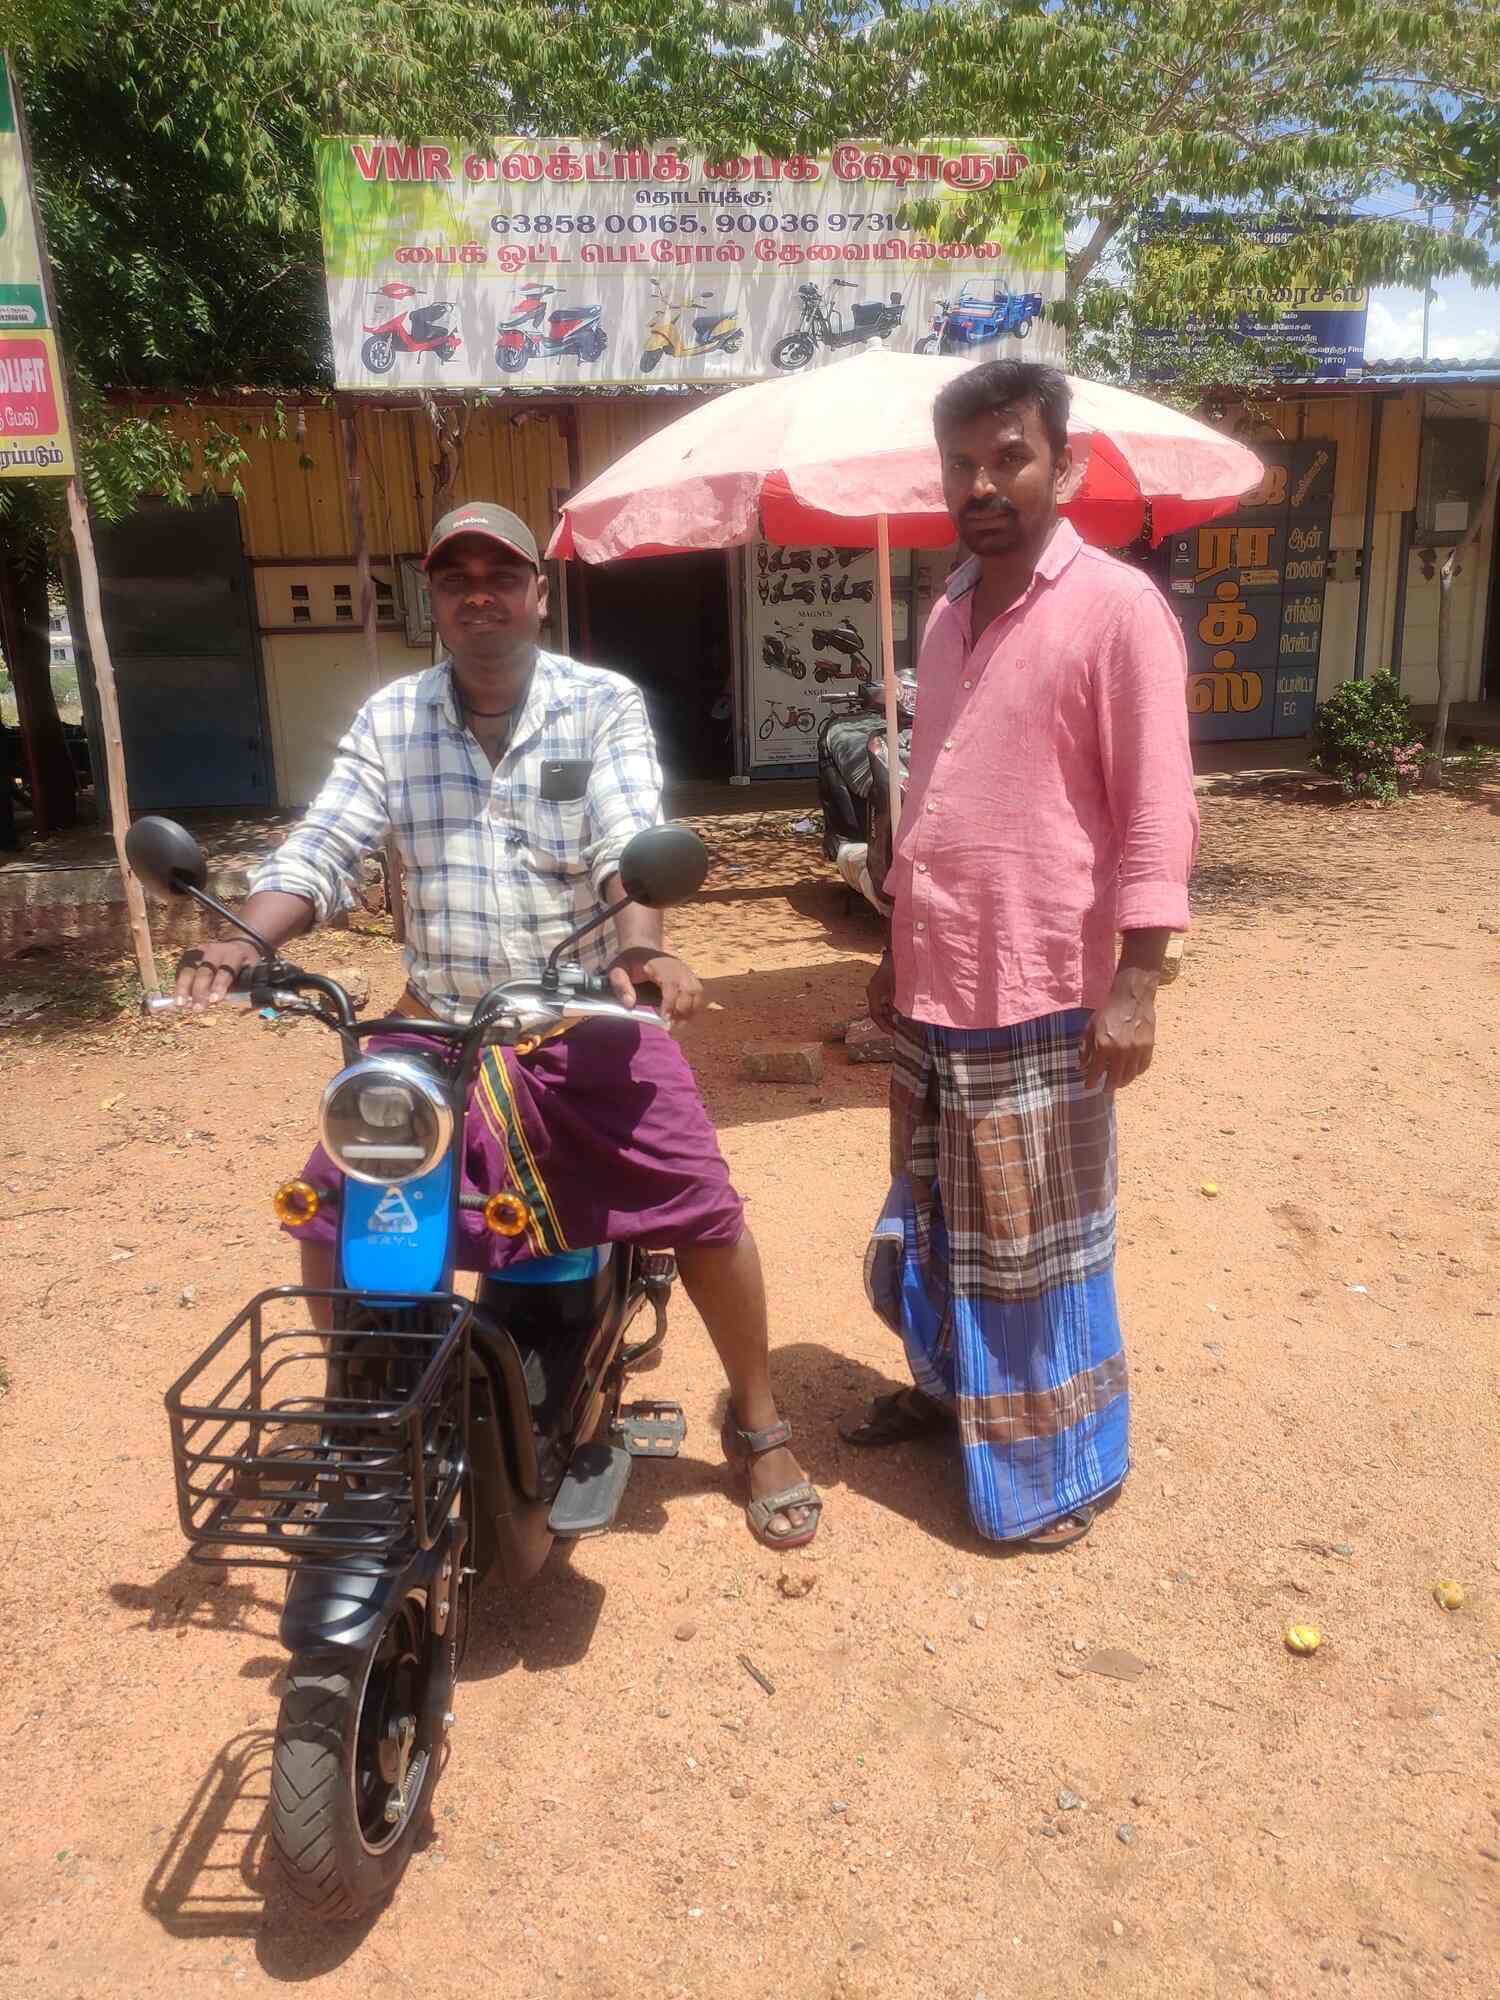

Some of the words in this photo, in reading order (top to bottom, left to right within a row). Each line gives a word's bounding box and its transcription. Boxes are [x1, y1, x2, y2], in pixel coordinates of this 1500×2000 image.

[352, 145, 454, 183] VMR
[490, 214, 595, 235] 63858
[716, 213, 819, 234] 90036
[395, 241, 488, 265] பைக்
[580, 239, 746, 266] பெட்ரோல்
[754, 238, 1002, 266] தேவையில்லை
